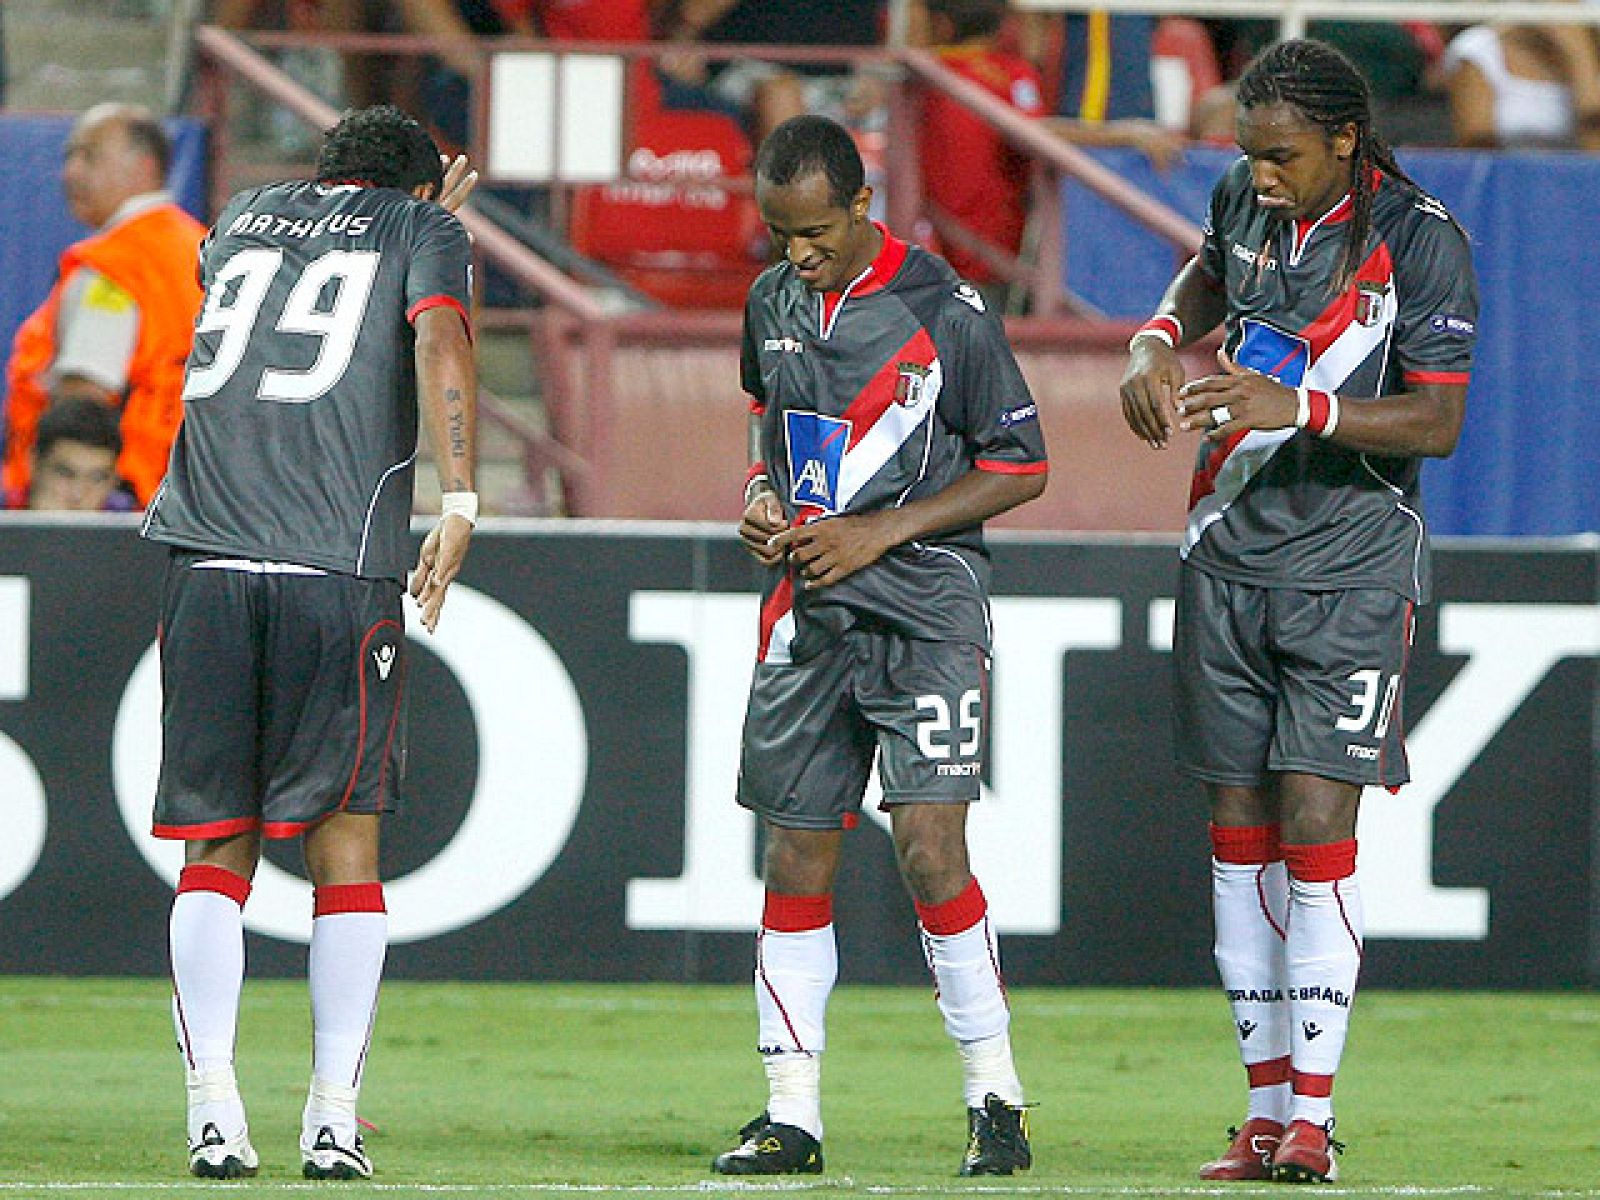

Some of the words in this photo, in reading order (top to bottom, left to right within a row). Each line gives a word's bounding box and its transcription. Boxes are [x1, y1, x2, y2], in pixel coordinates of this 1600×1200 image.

[181, 248, 380, 402] 99
[0, 575, 1600, 943] ONY
[914, 689, 981, 759] 25
[1334, 669, 1401, 738] 30
